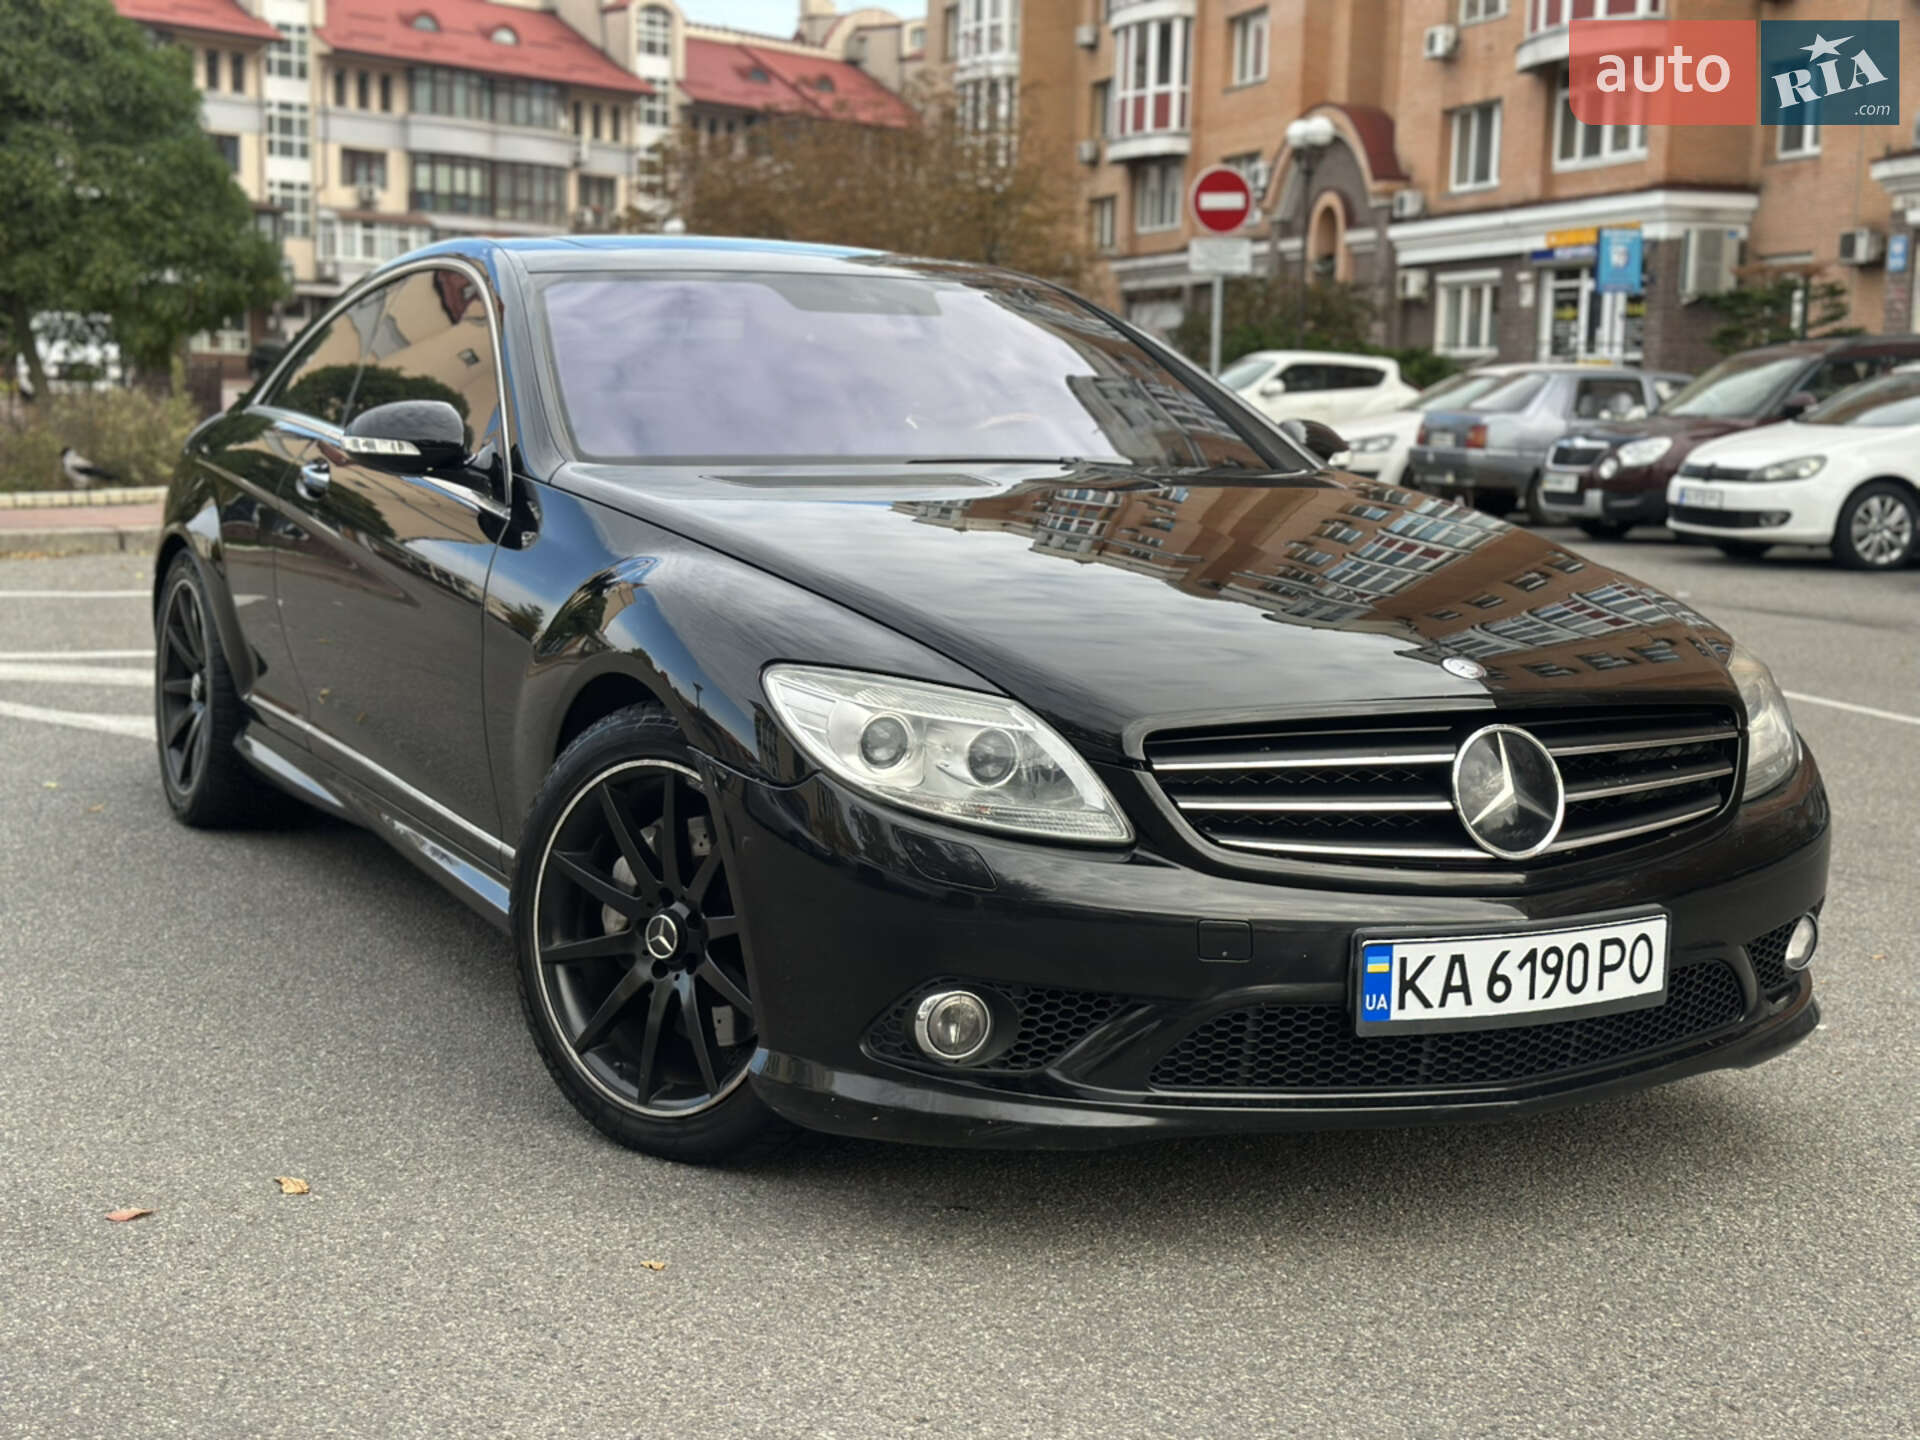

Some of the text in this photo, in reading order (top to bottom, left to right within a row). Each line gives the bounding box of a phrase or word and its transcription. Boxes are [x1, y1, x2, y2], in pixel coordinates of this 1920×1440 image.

[1398, 932, 1654, 1011] KA 6190 PO
[1365, 994, 1388, 1012] UA
